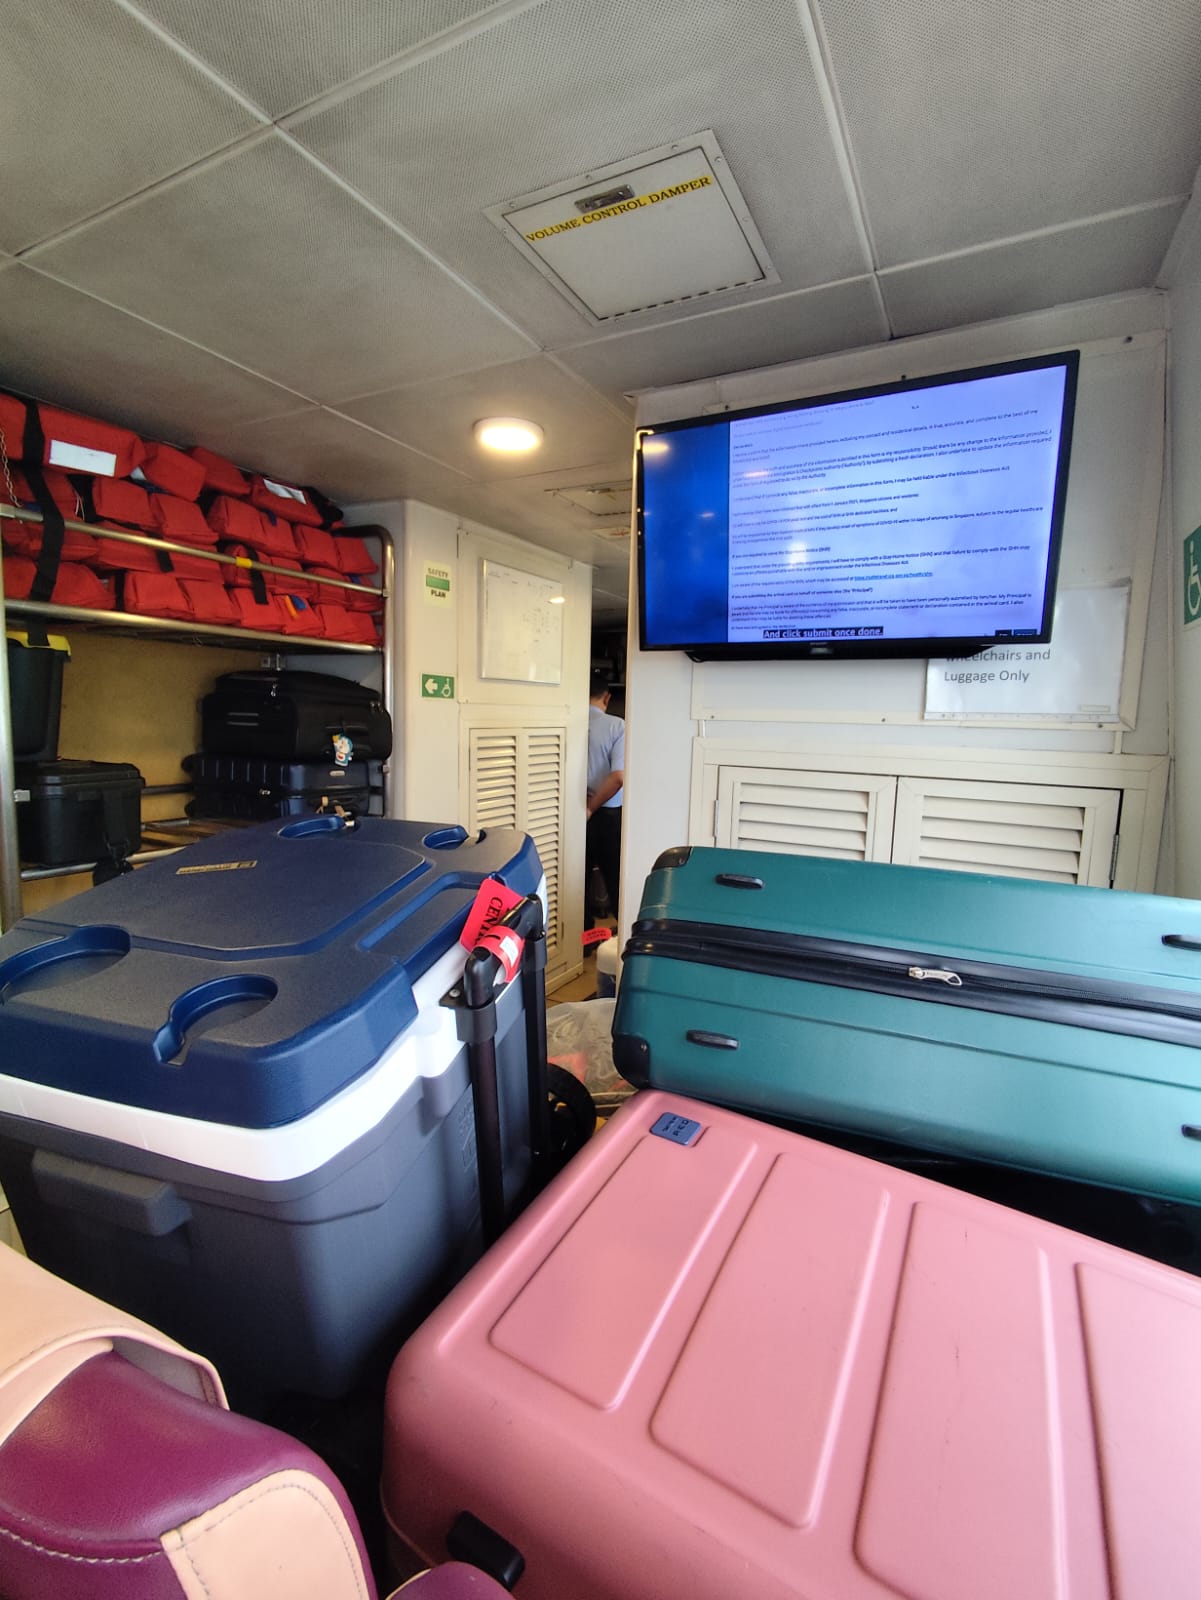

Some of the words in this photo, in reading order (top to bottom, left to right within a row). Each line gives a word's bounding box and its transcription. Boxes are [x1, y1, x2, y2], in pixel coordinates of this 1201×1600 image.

[525, 217, 580, 241] VOLUME
[582, 197, 645, 224] CONTROL
[647, 176, 710, 204] DAMPER
[431, 589, 446, 598] PLAN
[764, 630, 780, 639] And
[782, 629, 801, 638] click
[803, 628, 832, 638] submit
[834, 629, 856, 637] once
[946, 650, 1021, 662] elchairs
[1025, 648, 1051, 661] and
[944, 671, 995, 684] Luggage
[999, 669, 1030, 683] Only
